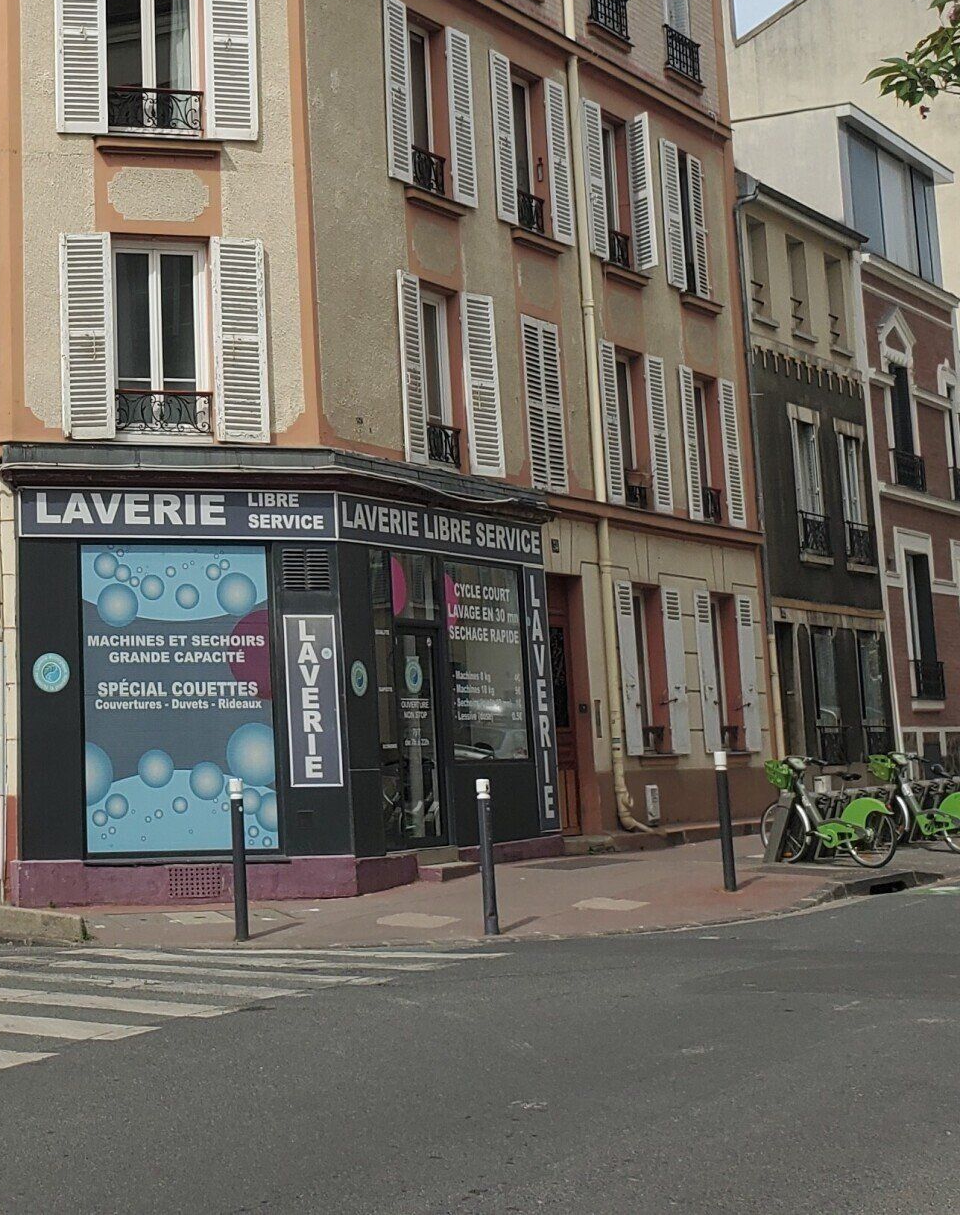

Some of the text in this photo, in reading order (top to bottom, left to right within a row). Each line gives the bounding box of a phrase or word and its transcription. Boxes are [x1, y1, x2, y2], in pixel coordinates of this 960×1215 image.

[36, 492, 227, 525] LAVERIE
[247, 492, 300, 508] LIBRE
[247, 513, 325, 530] SERVICE
[341, 500, 541, 555] LAVERIE LIBRE SERVICE
[453, 582, 510, 603] CYCLE COURT
[447, 603, 481, 621] LAVAGE
[482, 606, 494, 622] EN
[495, 608, 506, 623] 30
[87, 634, 265, 648] MACHINES ET SECHOIRS
[449, 625, 520, 644] SECHAGE RAPIDE
[108, 648, 246, 664] GRANDE CAPACITÉ
[97, 678, 259, 698] SPÉCIAL COUETTES
[529, 574, 555, 820] LAVERIE
[95, 699, 162, 710] Couvertures
[171, 698, 209, 710] Duvets
[218, 698, 263, 710] Rideaux
[297, 619, 324, 779] LAVERIE
[400, 700, 429, 709] OUVERTURE
